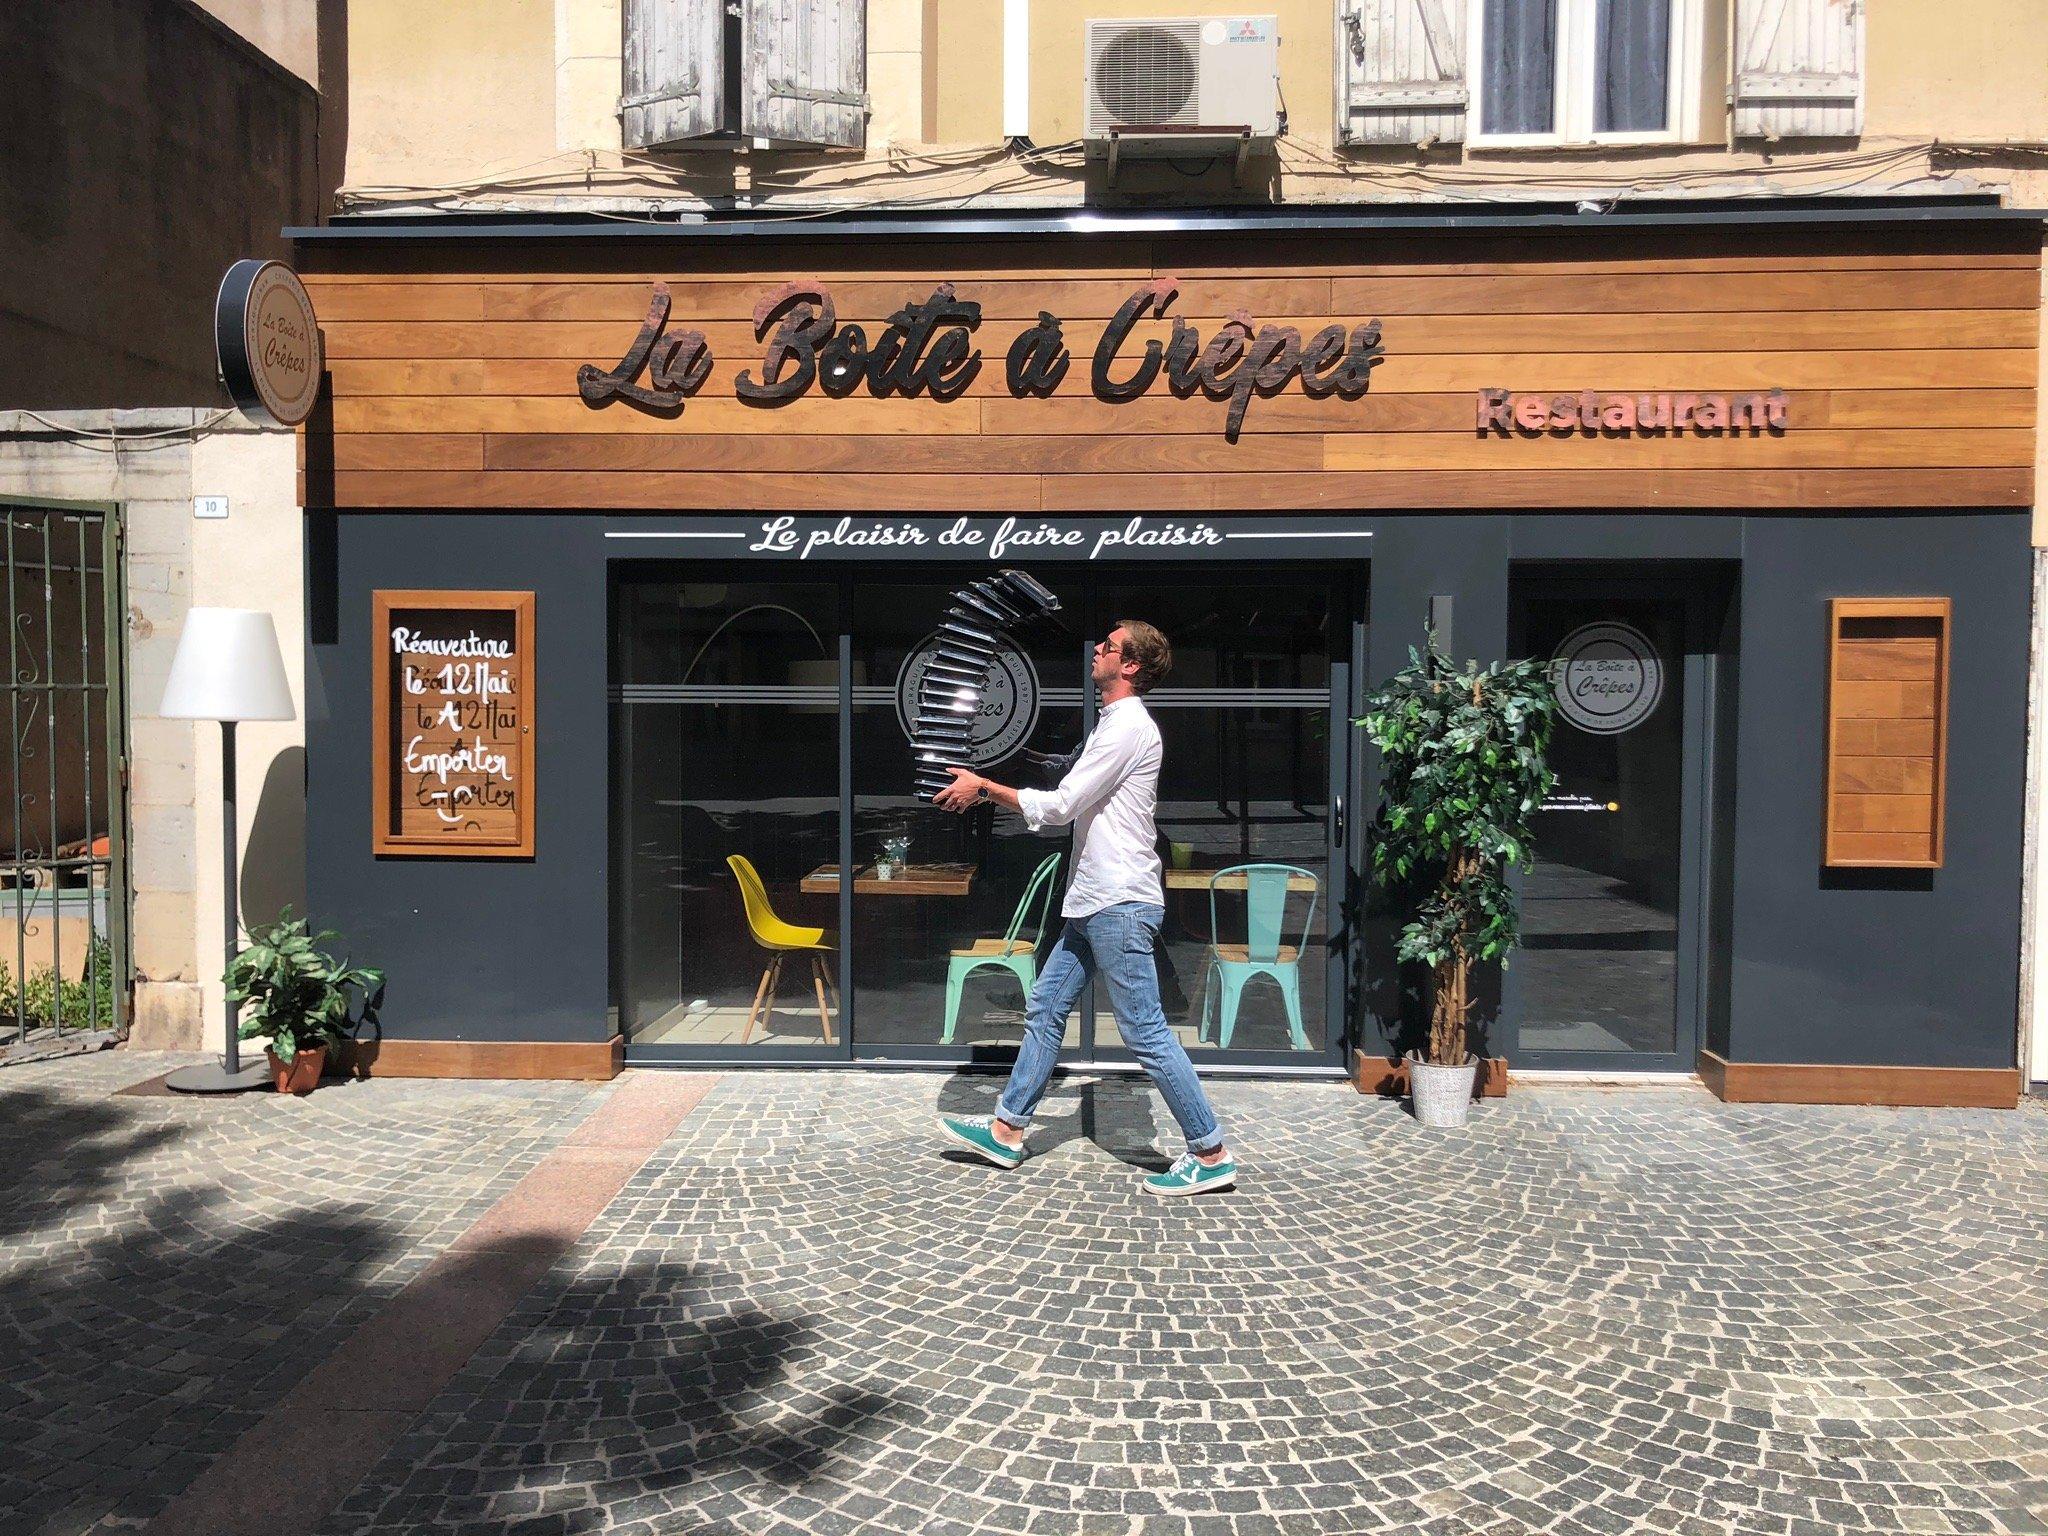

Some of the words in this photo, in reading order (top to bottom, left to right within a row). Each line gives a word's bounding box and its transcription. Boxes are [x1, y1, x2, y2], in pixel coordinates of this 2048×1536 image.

[263, 312, 275, 330] La
[265, 337, 306, 375] Crêpes
[577, 281, 713, 410] La
[1006, 311, 1070, 397] à
[1091, 277, 1385, 445] Crêpes
[1477, 388, 1790, 434] Restaurant
[205, 501, 217, 512] 10
[750, 516, 800, 552] Le
[800, 516, 930, 559] plaisir
[938, 516, 986, 546] de
[989, 516, 1085, 559] faire
[1089, 516, 1223, 559] plaisir
[391, 626, 514, 659] Réouverture
[1575, 659, 1592, 672] La
[437, 663, 473, 695] 12
[475, 661, 512, 705] Mai
[1576, 675, 1634, 699] Crêpes
[437, 700, 463, 732] A
[997, 719, 1024, 748] PLAISIR
[403, 735, 513, 785] Emporter
